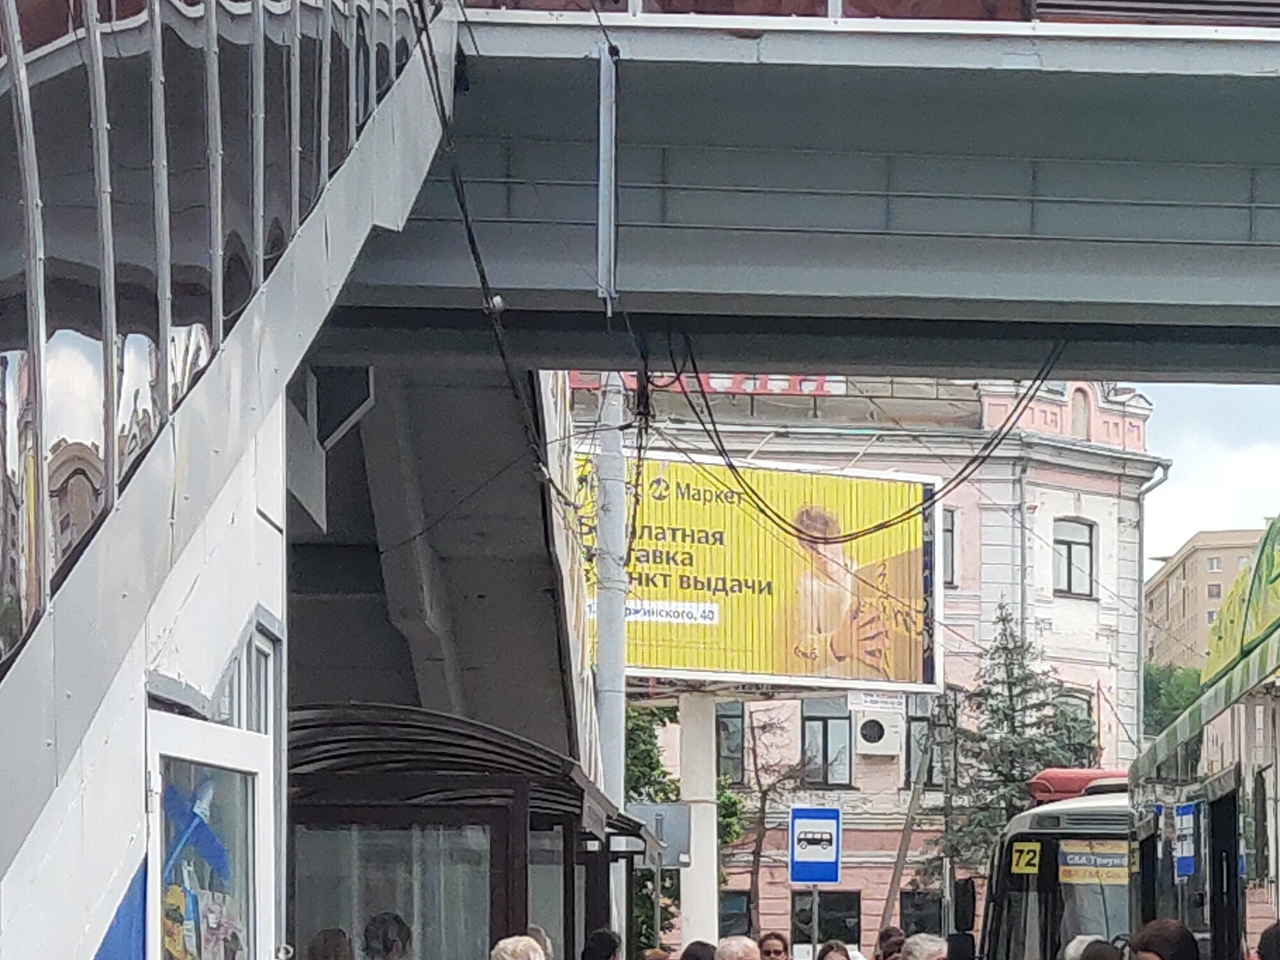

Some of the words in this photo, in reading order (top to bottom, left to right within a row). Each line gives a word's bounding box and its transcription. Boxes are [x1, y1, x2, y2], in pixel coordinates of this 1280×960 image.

[675, 481, 746, 505] Маркет
[578, 515, 726, 547] Блатная
[627, 571, 672, 589] нкт
[679, 576, 774, 598] выдачи
[625, 606, 698, 622] ржинского,
[1014, 848, 1037, 867] 72
